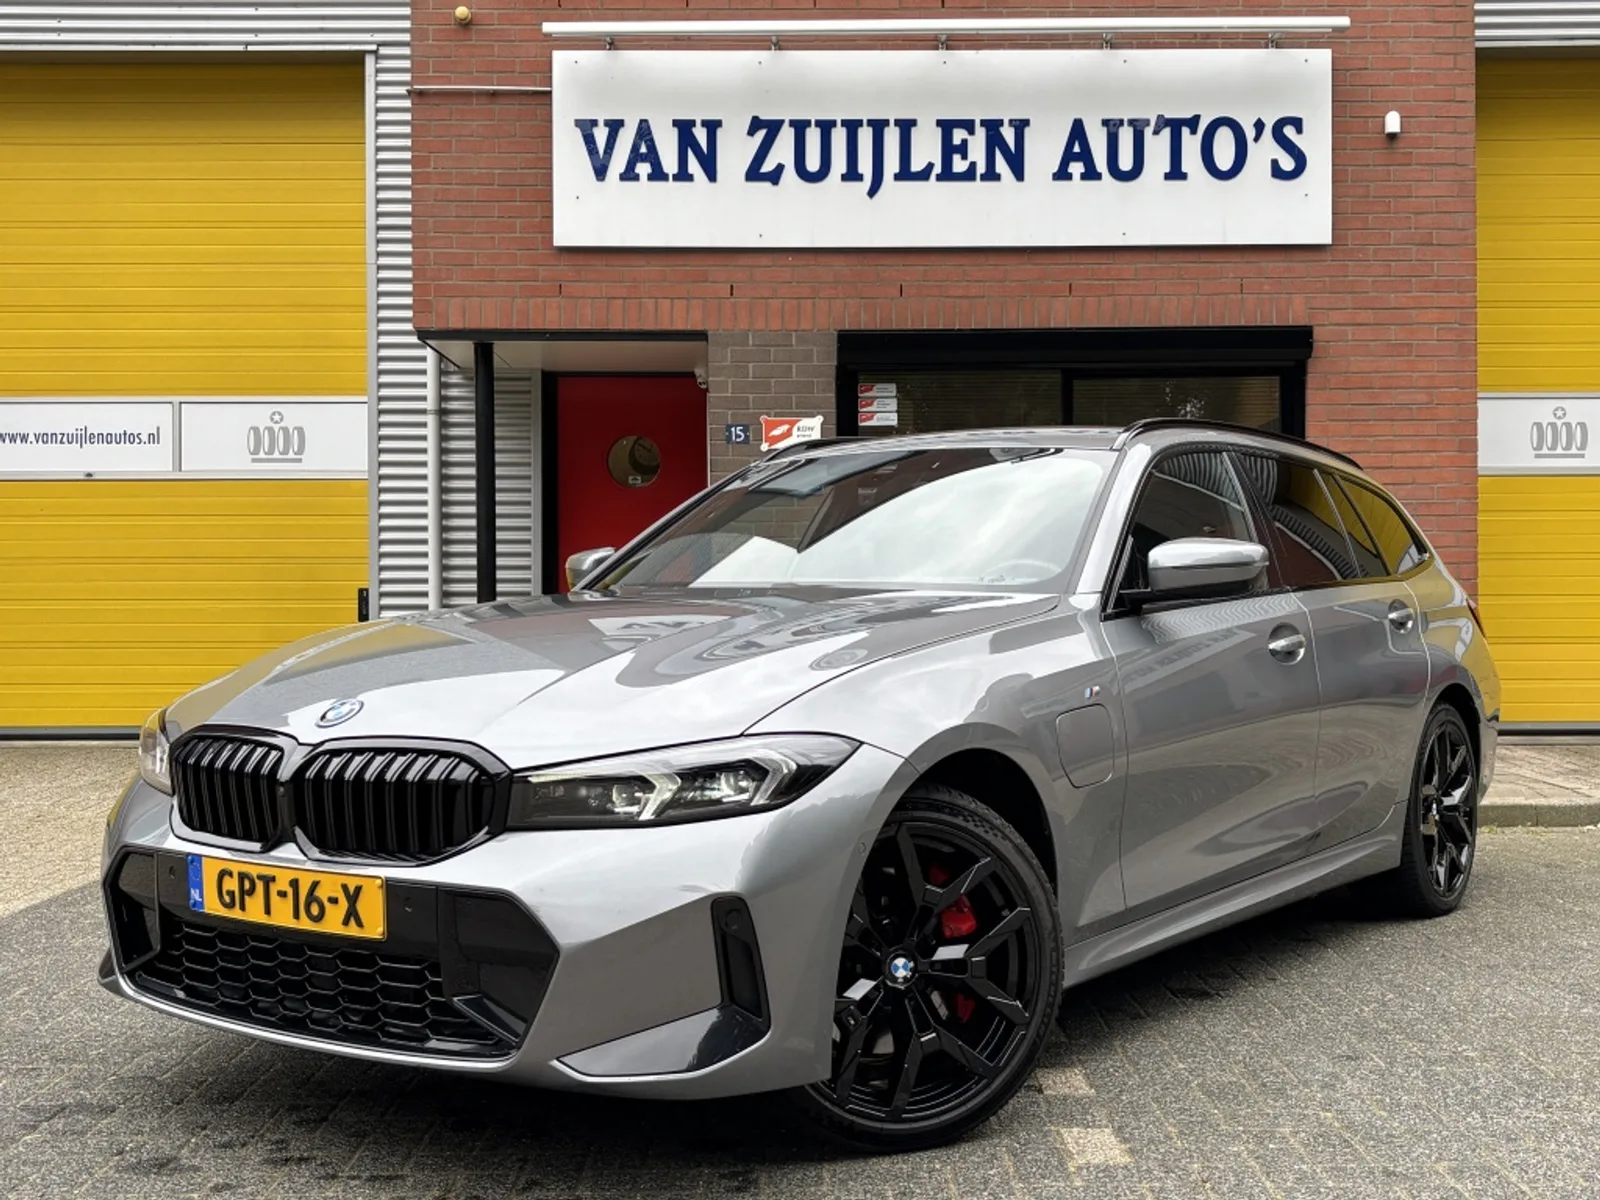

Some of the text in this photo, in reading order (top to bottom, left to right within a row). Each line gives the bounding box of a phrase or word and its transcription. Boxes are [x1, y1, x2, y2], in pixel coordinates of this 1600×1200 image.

[574, 113, 1308, 200] VAN ZUIJLEN AUTO'S
[0, 425, 161, 449] www.vanzuijlenautos.nl
[730, 426, 745, 442] 15
[215, 867, 365, 929] GPT-16-X
